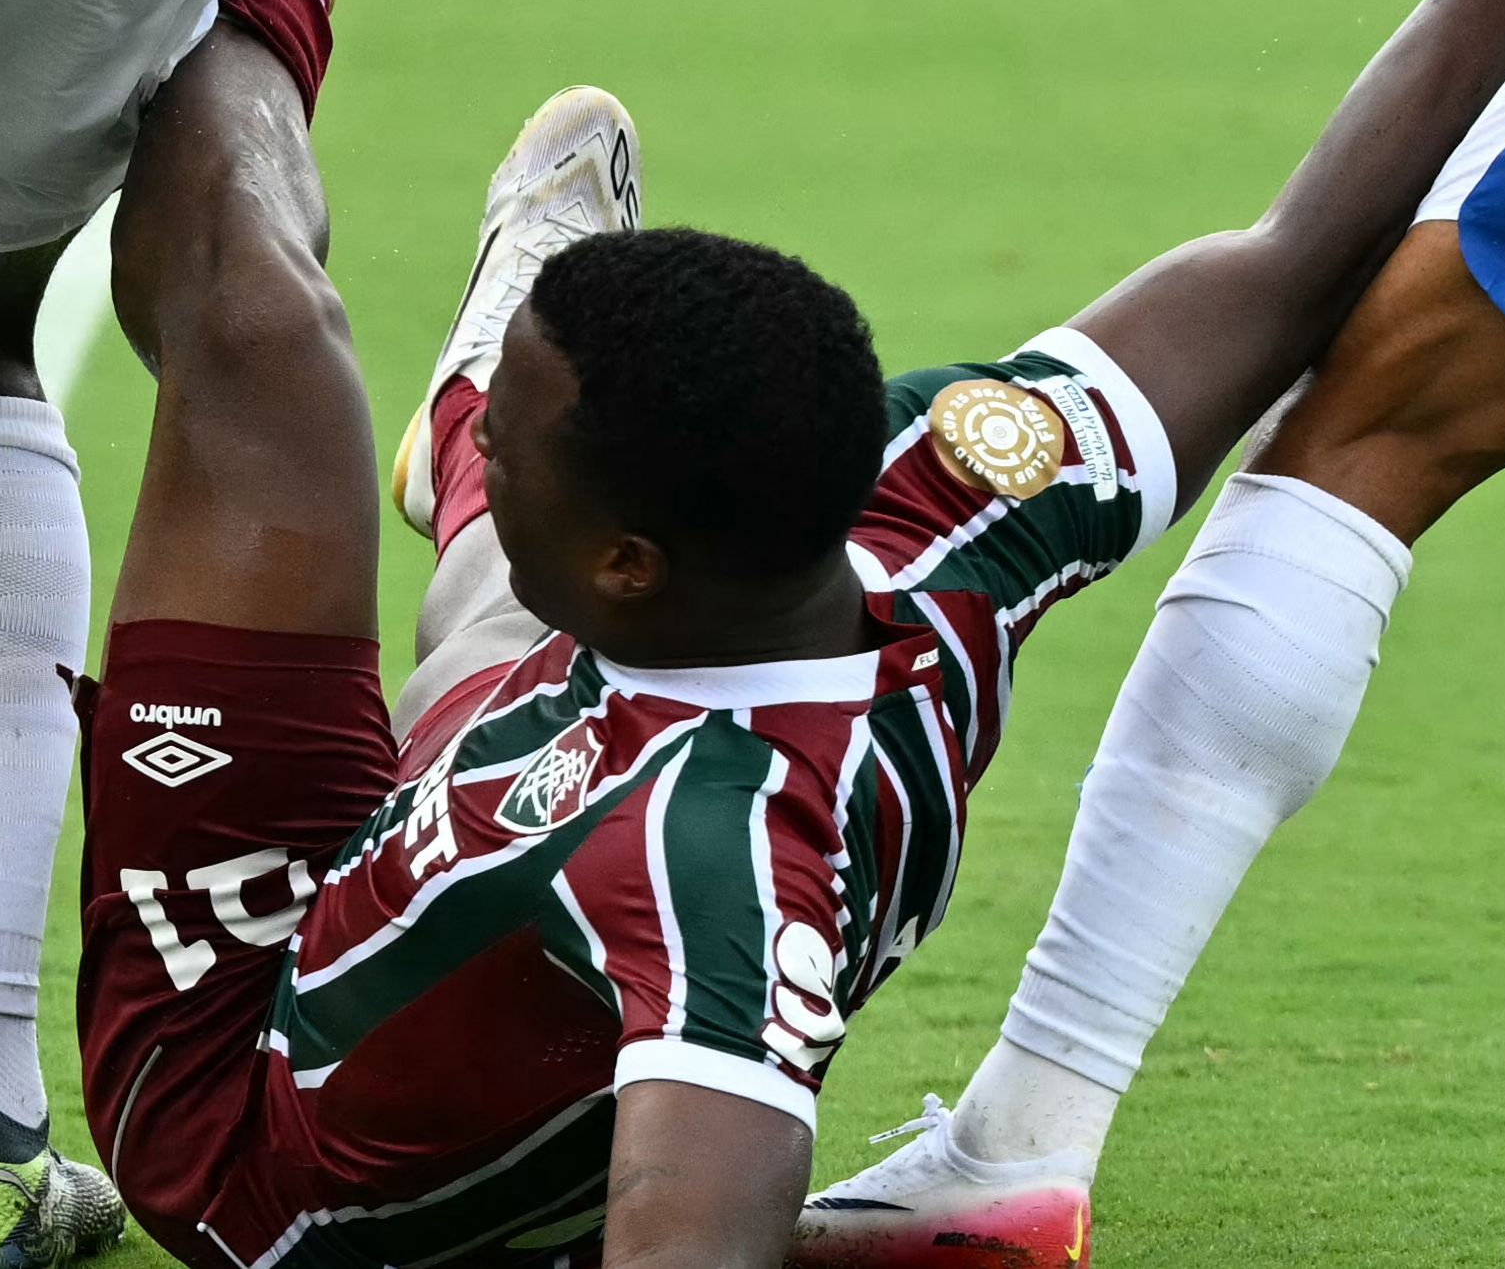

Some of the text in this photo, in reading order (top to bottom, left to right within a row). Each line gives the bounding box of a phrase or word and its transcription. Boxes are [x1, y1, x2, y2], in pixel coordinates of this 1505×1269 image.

[943, 410, 958, 442] CUP
[1015, 450, 1050, 485] CLUB
[129, 702, 222, 728] umbro
